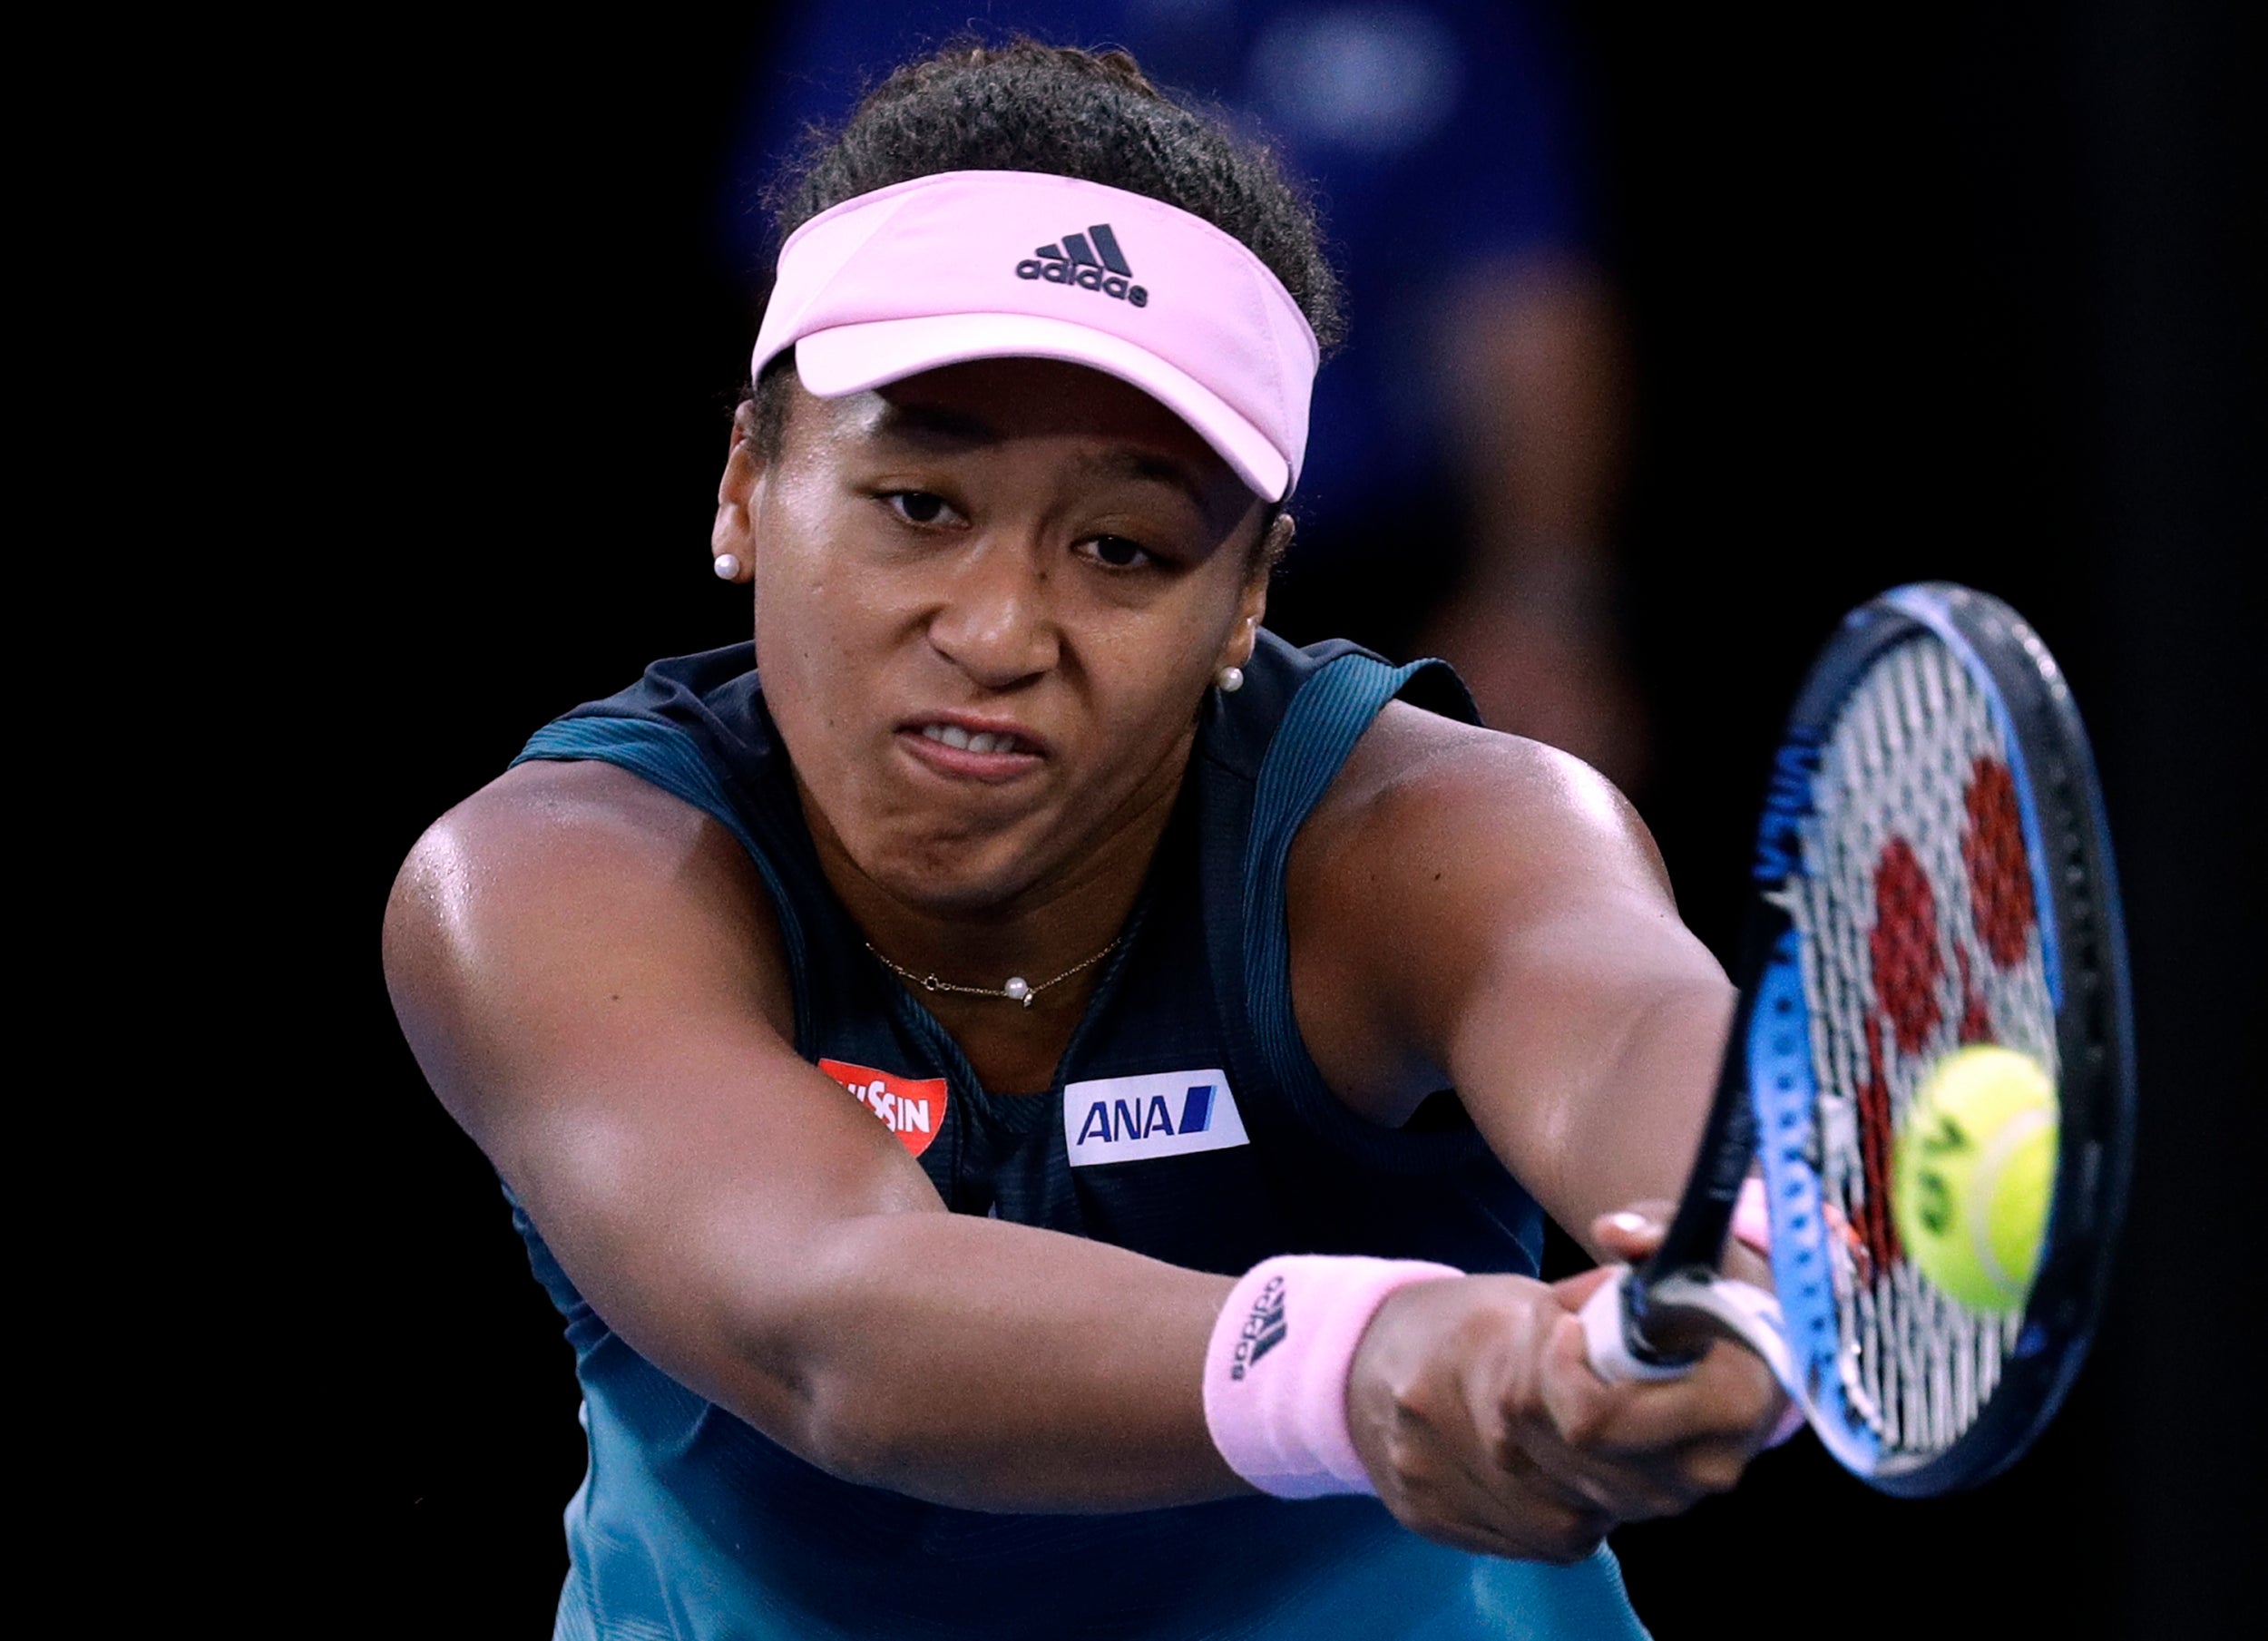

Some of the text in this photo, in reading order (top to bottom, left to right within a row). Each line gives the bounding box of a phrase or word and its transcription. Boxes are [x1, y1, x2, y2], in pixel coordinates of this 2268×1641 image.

[1015, 259, 1149, 308] adidas
[1076, 1095, 1175, 1146] ANA
[1230, 1275, 1285, 1381] adidas
